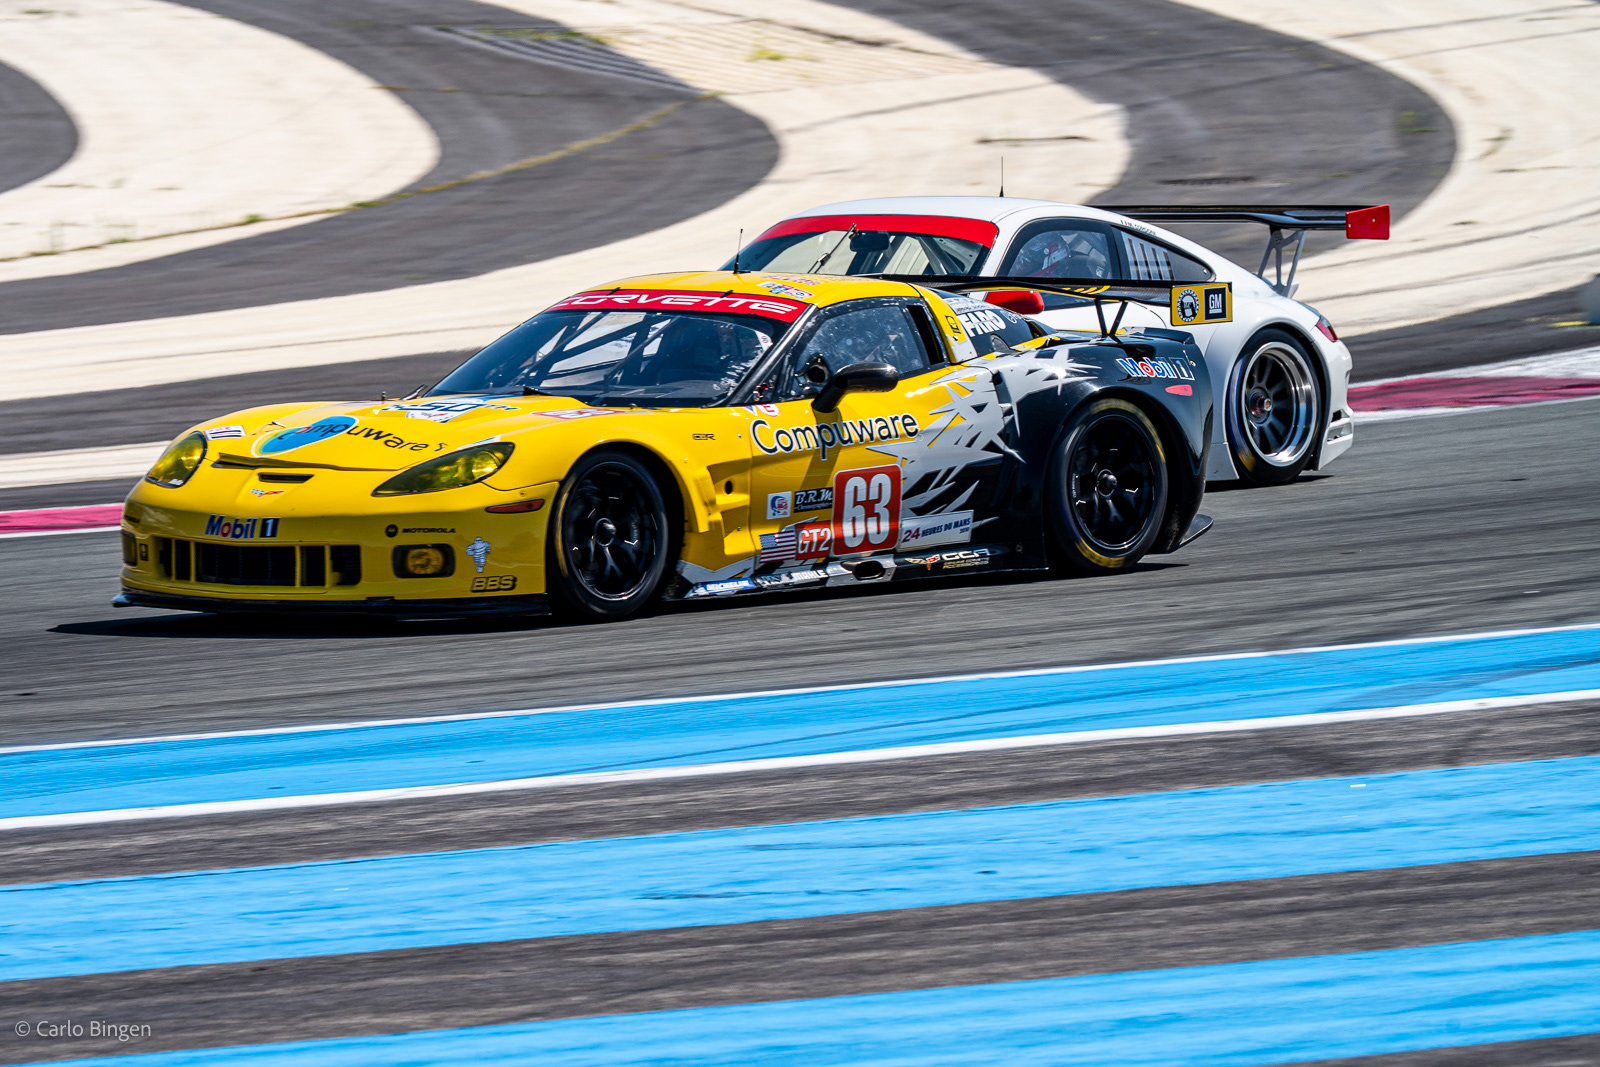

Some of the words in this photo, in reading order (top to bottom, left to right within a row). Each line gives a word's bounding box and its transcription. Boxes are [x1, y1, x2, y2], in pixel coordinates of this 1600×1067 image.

[550, 294, 798, 315] CORVETTE
[1208, 294, 1223, 310] GM
[957, 309, 1007, 337] FARO
[1116, 357, 1177, 379] Mobil
[1175, 359, 1192, 379] 1
[751, 413, 920, 460] Compuware
[842, 473, 892, 548] 63
[205, 514, 258, 539] Mobil
[263, 517, 276, 538] 1
[902, 528, 921, 543] 24
[921, 525, 943, 537] HEURES
[944, 522, 953, 532] DU
[953, 518, 971, 529] MANS
[798, 528, 832, 555] GT2
[471, 575, 516, 592] BBS
